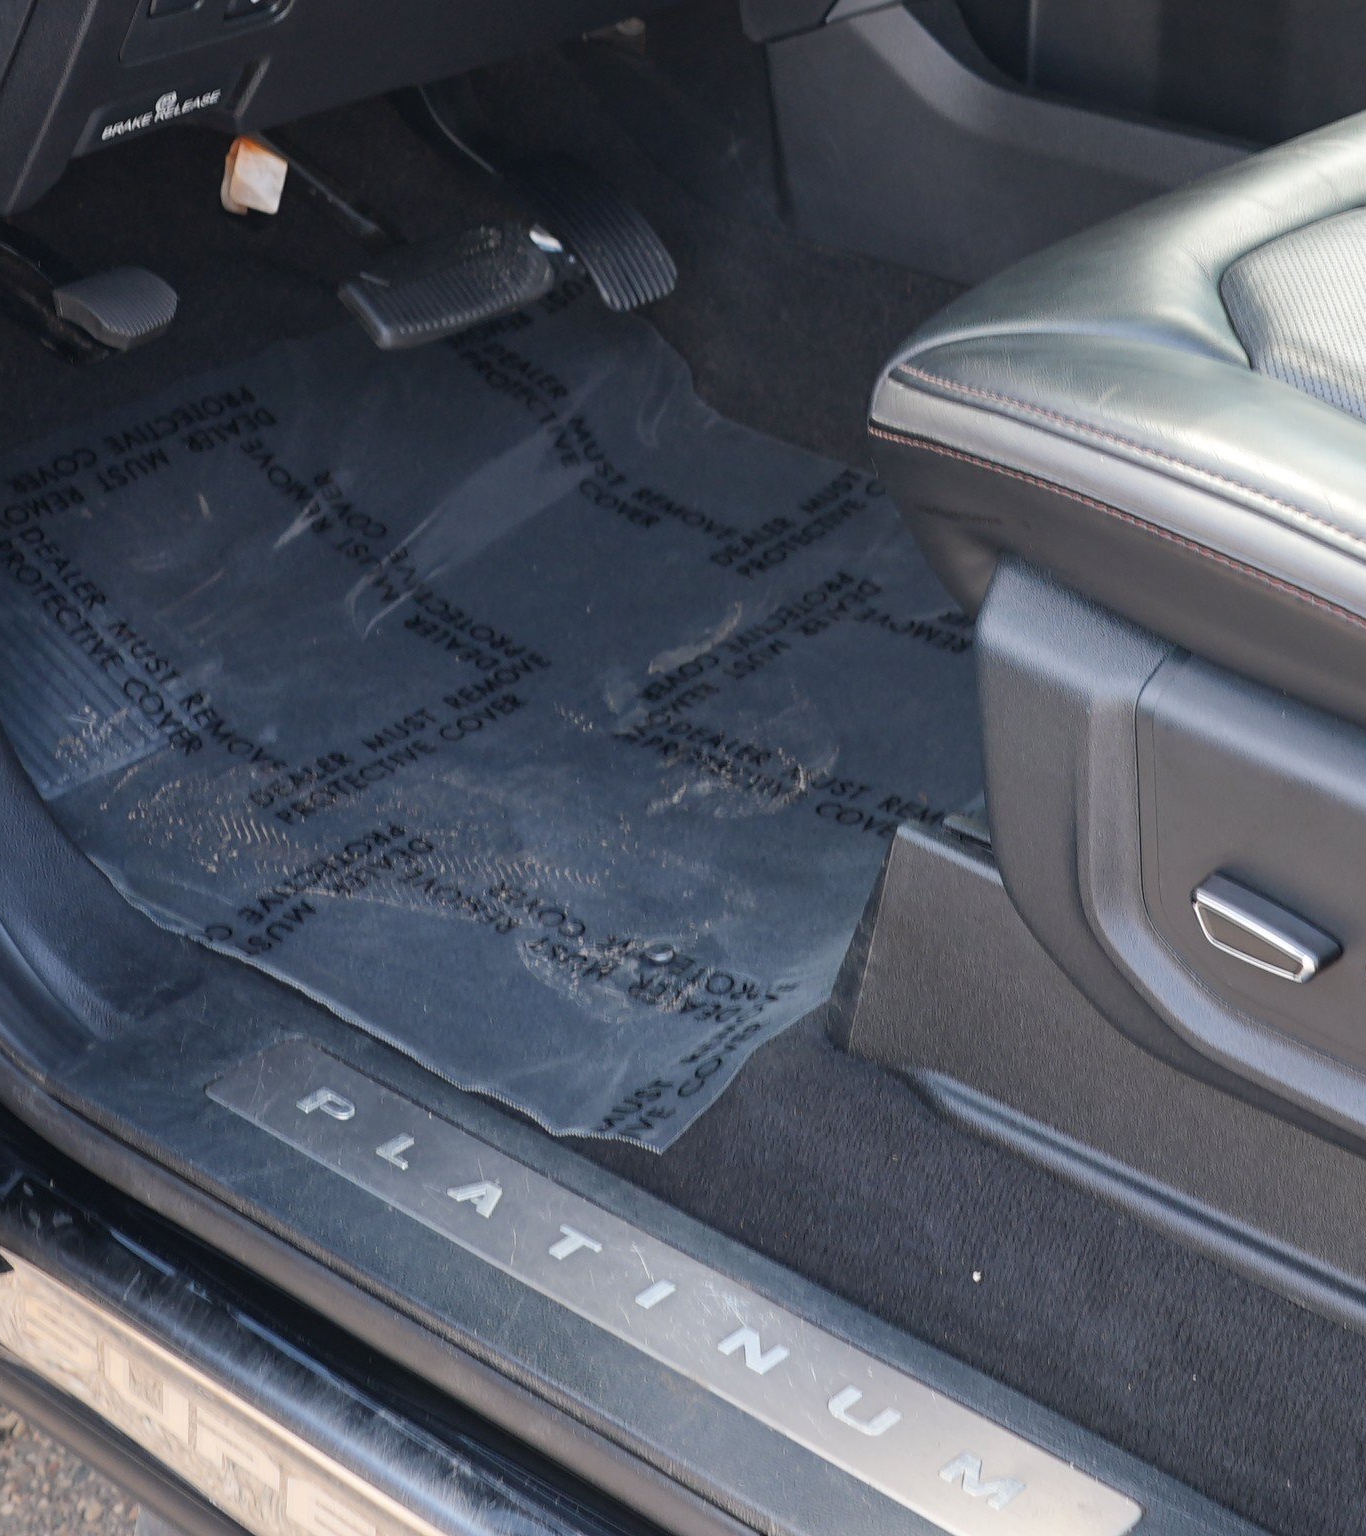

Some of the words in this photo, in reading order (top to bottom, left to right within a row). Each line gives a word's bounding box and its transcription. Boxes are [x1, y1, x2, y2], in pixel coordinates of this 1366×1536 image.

[101, 110, 154, 141] BRAKE
[153, 88, 223, 124] RELEASE
[102, 384, 256, 456] PROTECTIVE
[180, 406, 278, 455] DEALER
[6, 446, 98, 495] COVER
[96, 446, 172, 495] MUST
[567, 414, 627, 486] MUST
[631, 486, 739, 542] REMOVE
[579, 477, 661, 529] COVER
[313, 468, 389, 541] COVER
[709, 516, 795, 568] DEALER
[799, 468, 863, 514] MUST
[735, 499, 868, 580] PROTECTIVE
[795, 578, 883, 636] DEALER
[18, 525, 108, 609] DEALER
[107, 617, 183, 685] MUST
[177, 686, 289, 771] REMOVE
[404, 612, 501, 671] DEALER
[722, 637, 793, 681] MUST
[637, 653, 721, 704] COVER
[122, 676, 205, 758] COVER
[249, 751, 356, 810] DEALER
[361, 706, 437, 753] MUST
[441, 651, 552, 710] REMOVE
[274, 739, 438, 825] PROTECTIVE
[438, 694, 528, 742] COVER
[815, 801, 897, 839] COVE
[295, 1085, 1029, 1513] PLATINUM
